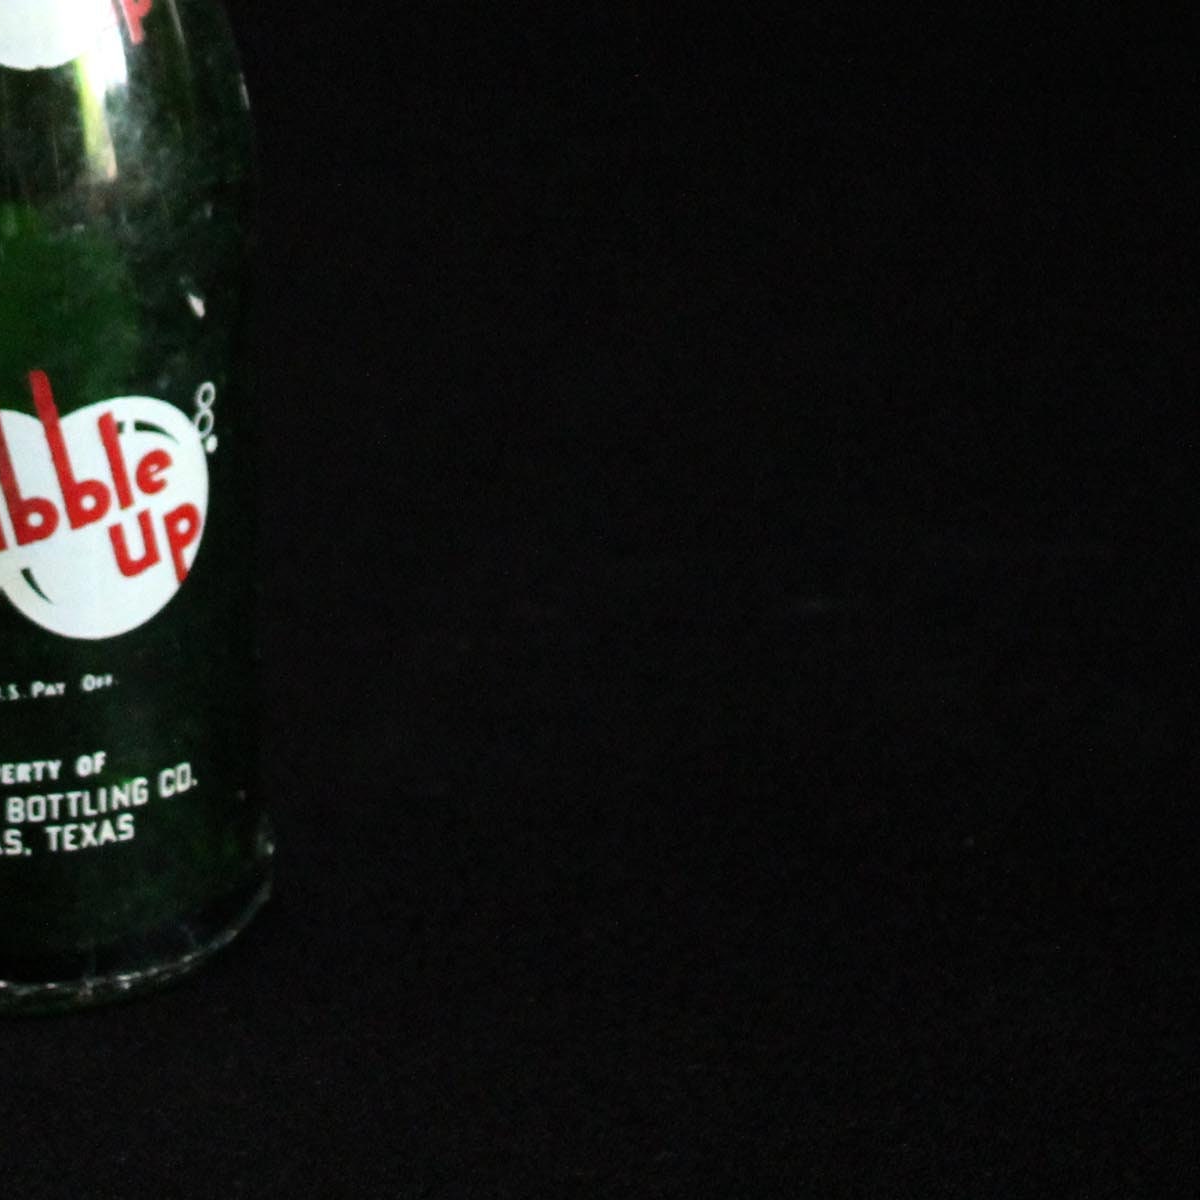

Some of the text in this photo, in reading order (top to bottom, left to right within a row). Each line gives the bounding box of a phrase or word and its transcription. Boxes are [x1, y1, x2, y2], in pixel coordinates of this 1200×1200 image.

[108, 502, 200, 584] up
[75, 751, 107, 777] OF
[5, 777, 149, 824] BOTTLING
[157, 762, 198, 799] CO.
[45, 813, 136, 852] TEXAS
